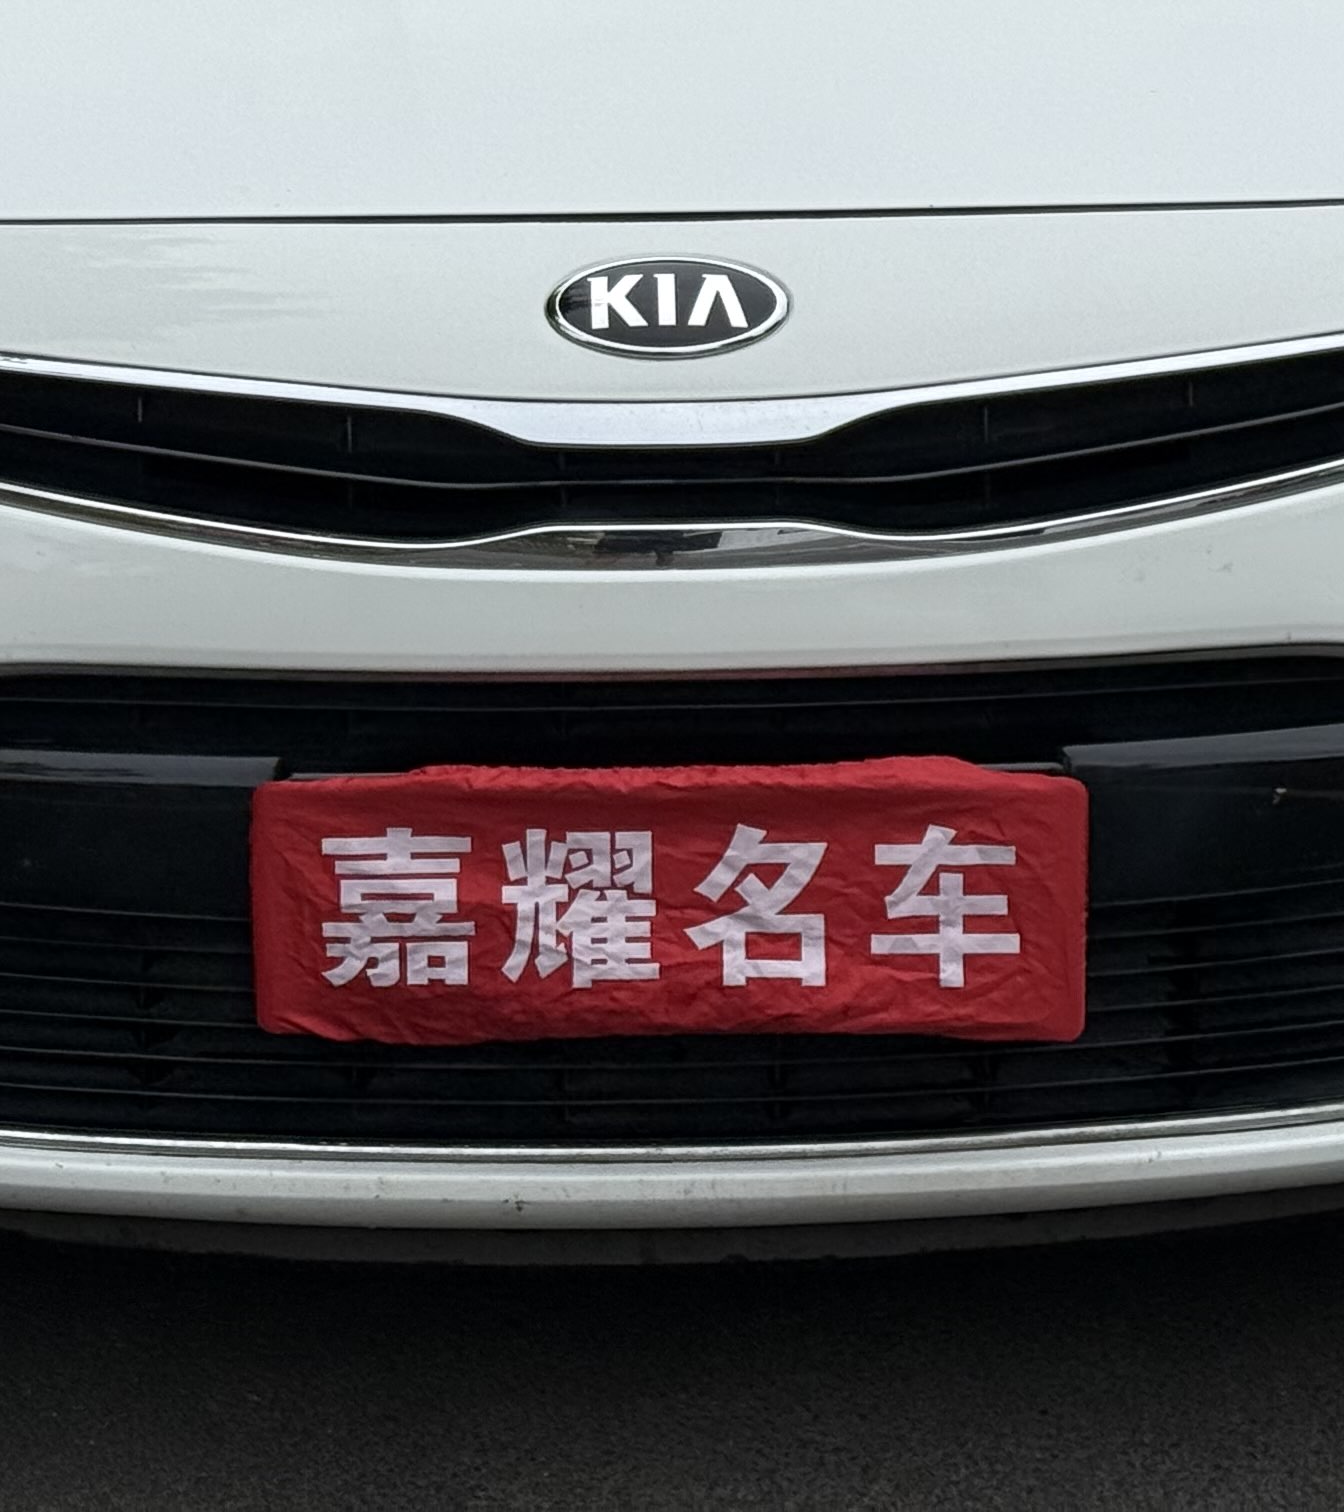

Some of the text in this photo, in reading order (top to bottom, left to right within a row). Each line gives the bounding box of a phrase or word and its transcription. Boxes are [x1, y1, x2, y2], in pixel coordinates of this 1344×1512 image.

[586, 273, 749, 330] KIA
[321, 823, 1021, 989] 嘉耀名车
